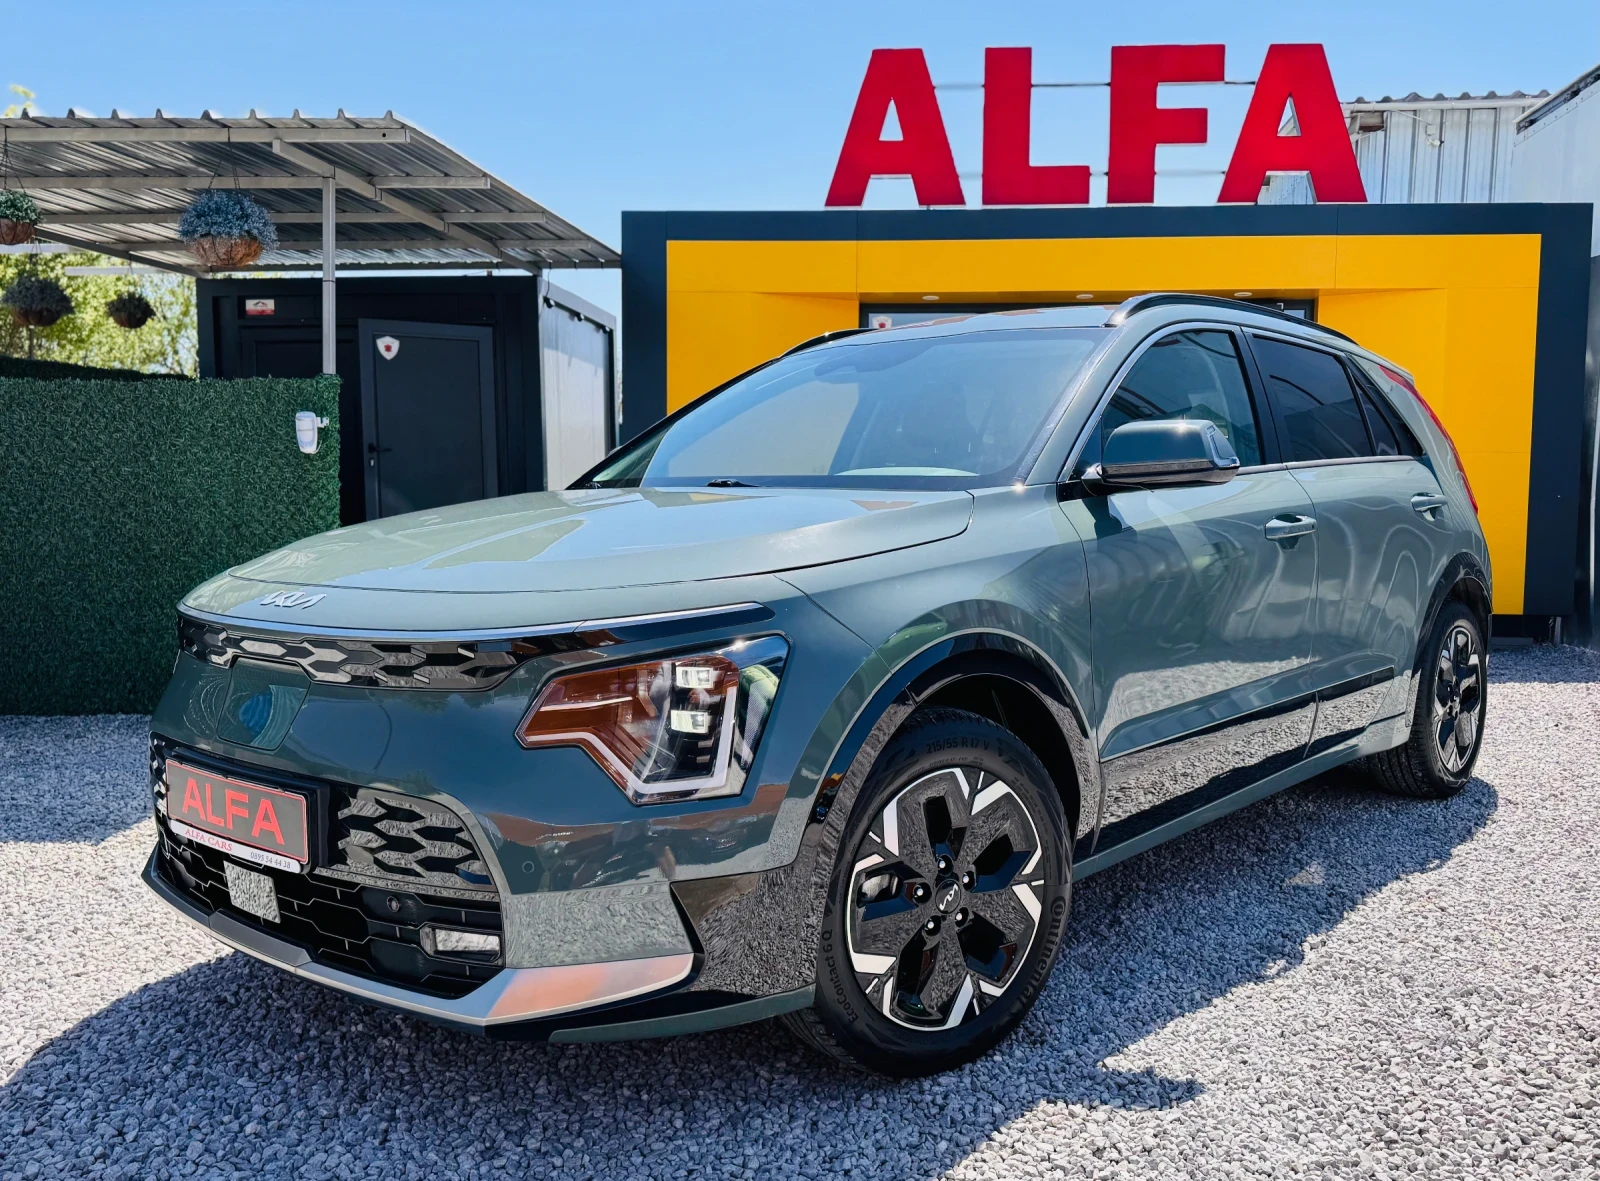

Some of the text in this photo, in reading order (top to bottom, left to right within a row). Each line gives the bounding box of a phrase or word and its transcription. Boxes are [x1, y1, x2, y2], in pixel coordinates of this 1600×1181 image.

[824, 43, 1368, 207] ALFA
[259, 590, 327, 610] KIA
[926, 737, 990, 754] 215/55 R 17 V
[182, 777, 285, 845] ALFA
[185, 828, 233, 852] ALFA CARS
[250, 851, 264, 861] 0895
[265, 855, 273, 863] 54
[283, 861, 291, 869] 38
[1017, 895, 1066, 1009] Continental
[821, 929, 859, 1023] EcoContact 6 Q
